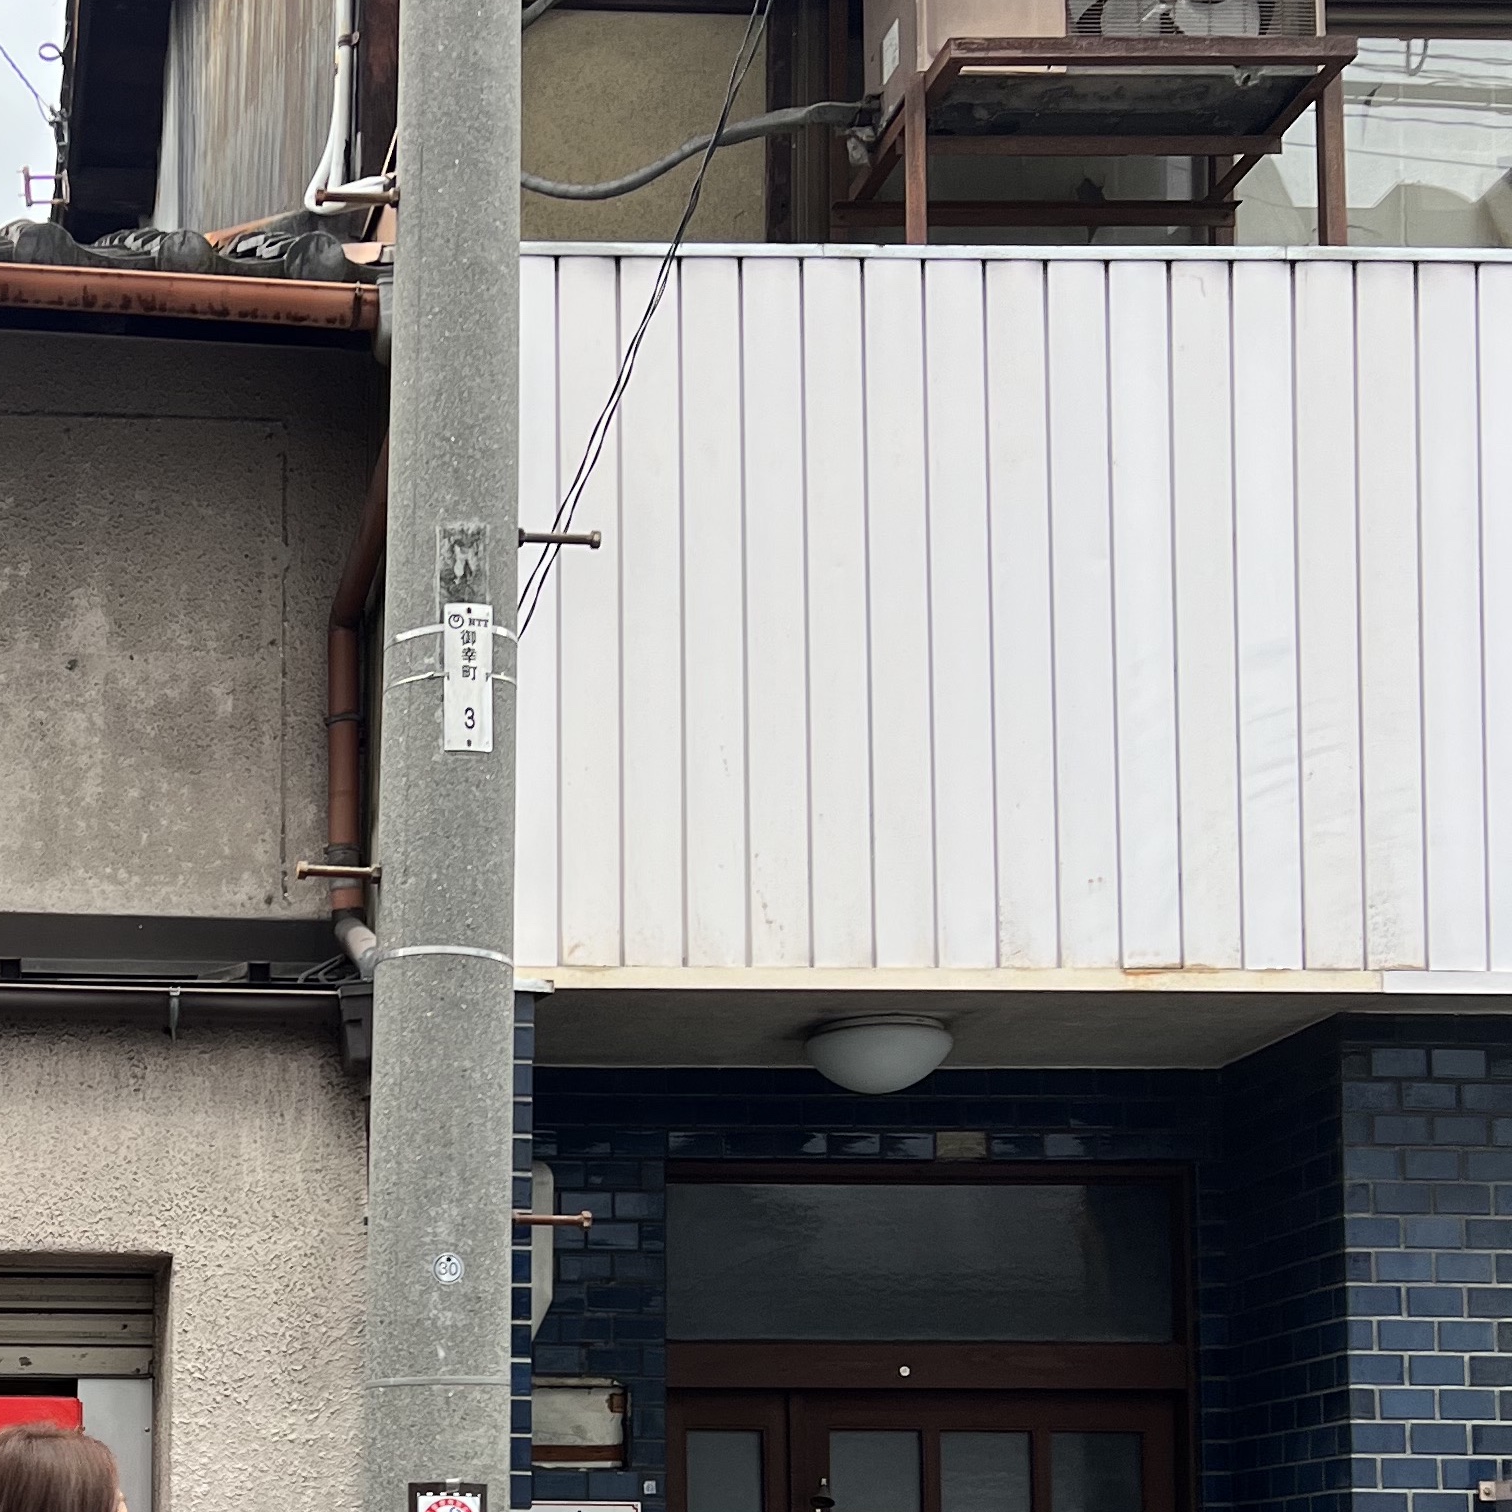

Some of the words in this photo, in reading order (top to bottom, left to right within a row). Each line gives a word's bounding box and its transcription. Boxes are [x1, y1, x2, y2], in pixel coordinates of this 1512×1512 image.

[468, 618, 489, 627] NTT
[460, 629, 477, 681] 御幸町
[464, 706, 475, 729] 3
[438, 1261, 458, 1276] 30
